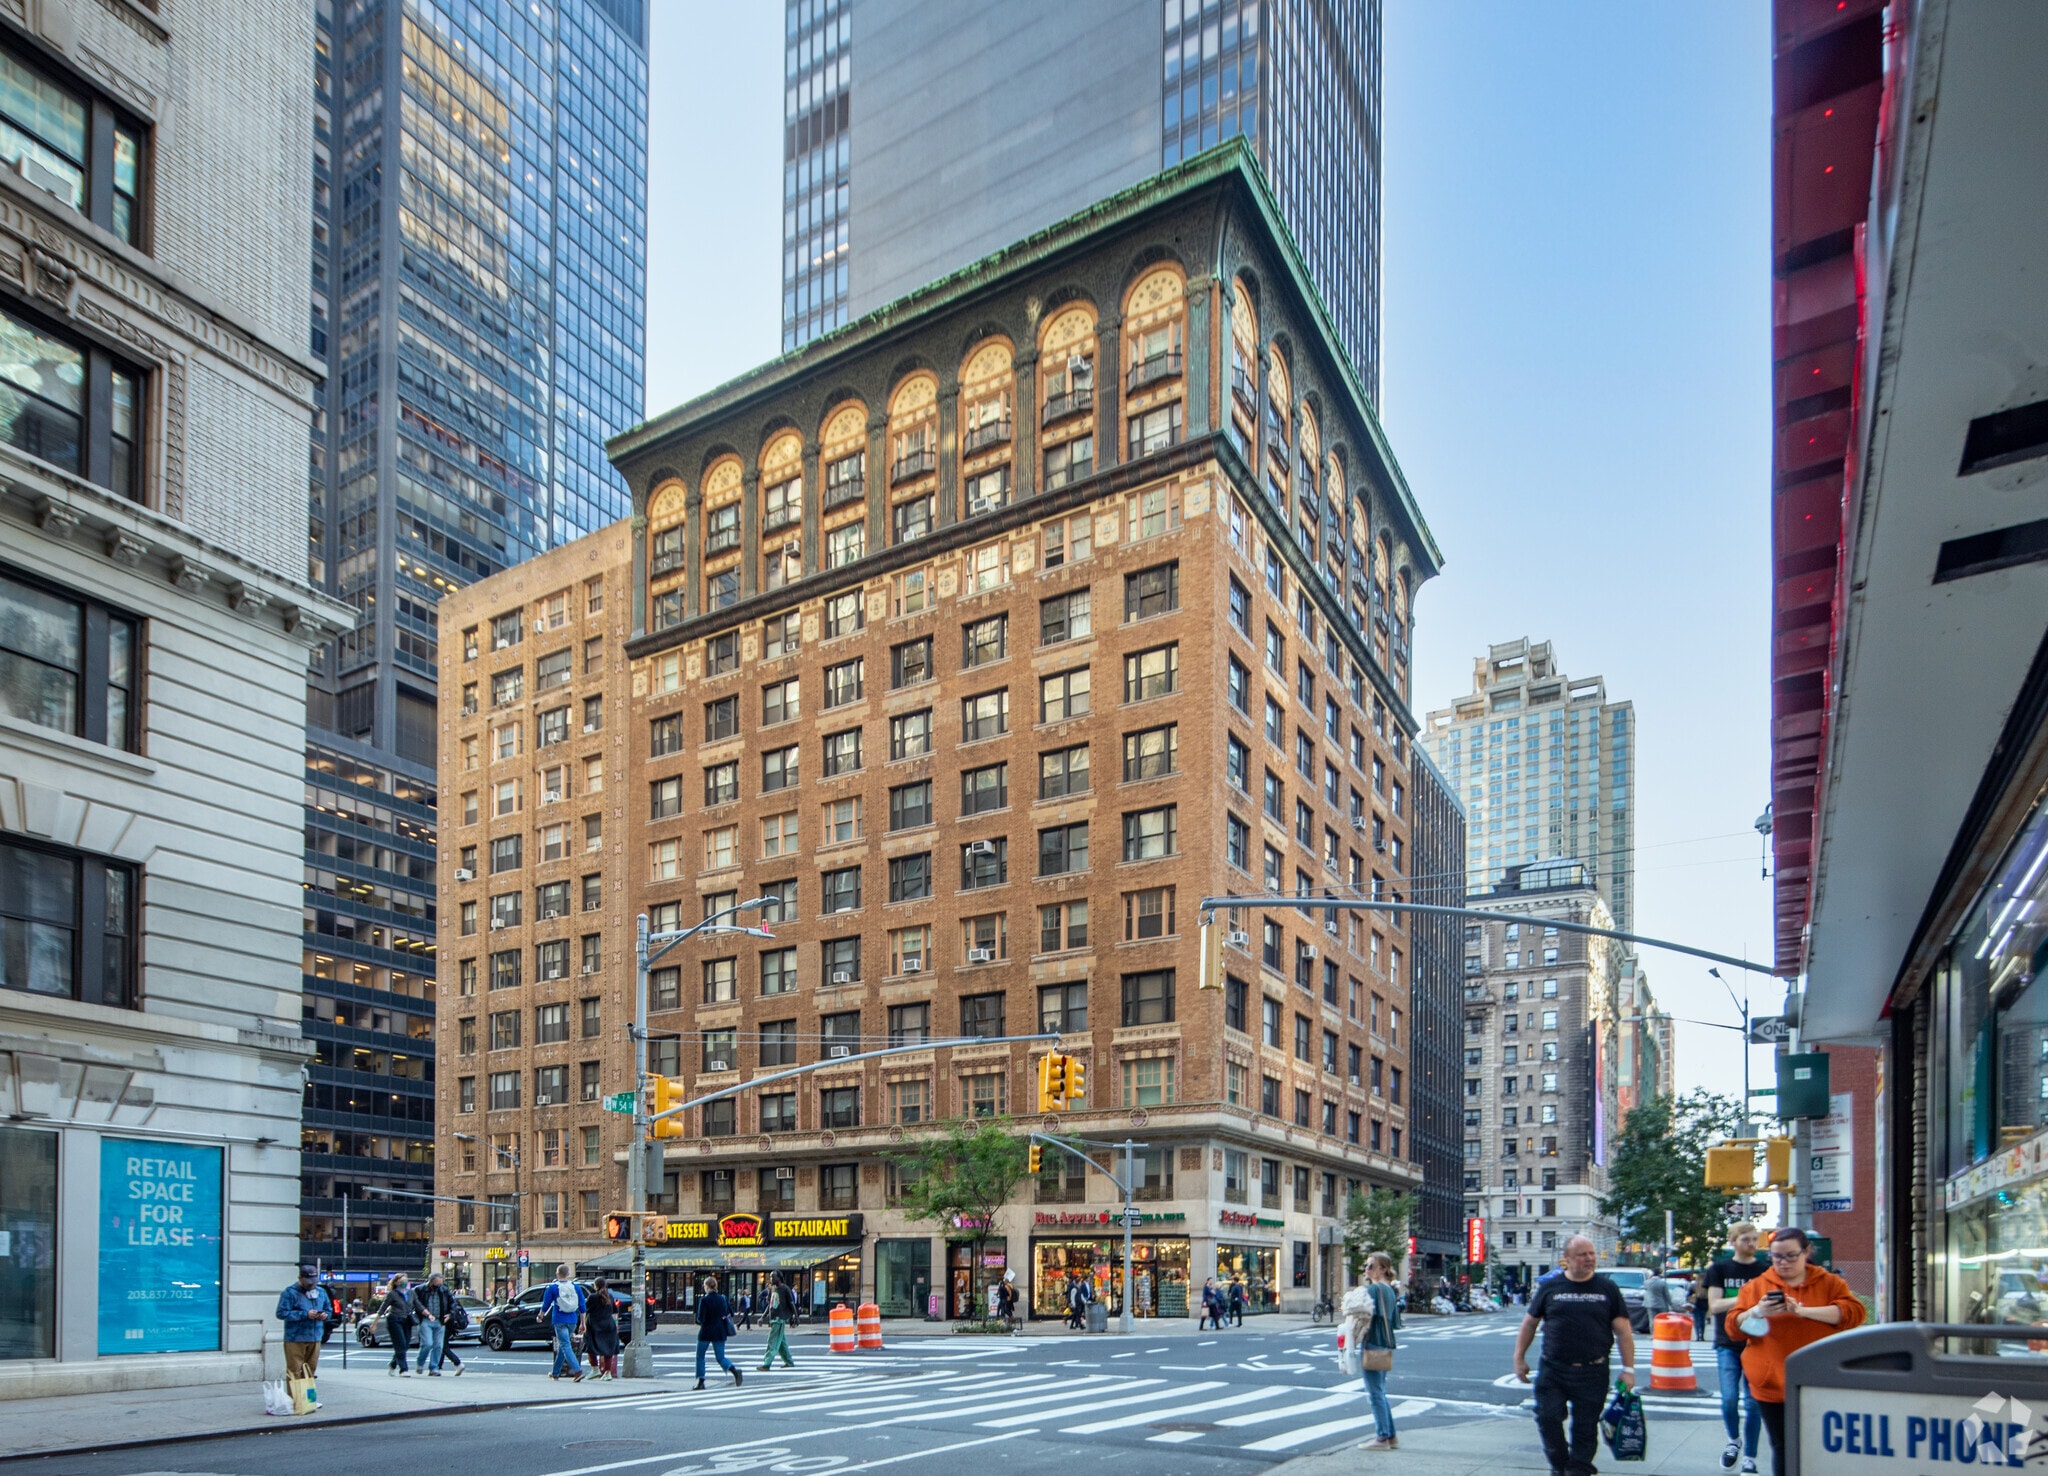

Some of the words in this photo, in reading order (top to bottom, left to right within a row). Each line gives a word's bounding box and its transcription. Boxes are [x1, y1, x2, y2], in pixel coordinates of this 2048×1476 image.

[619, 1100, 627, 1111] 54
[126, 1157, 197, 1180] RETAIL
[1812, 1157, 1821, 1170] 6
[128, 1180, 194, 1202] SPACE
[140, 1203, 183, 1223] FOR
[1035, 1211, 1056, 1224] BIG
[1057, 1211, 1096, 1224] APPLE
[128, 1225, 194, 1246] LEASE
[667, 1222, 709, 1239] ATESSEN
[773, 1219, 850, 1237] RESTAURANT
[1723, 1278, 1746, 1288] IREL
[1822, 1410, 1896, 1458] CELL
[1906, 1415, 2026, 1469] PHONE
